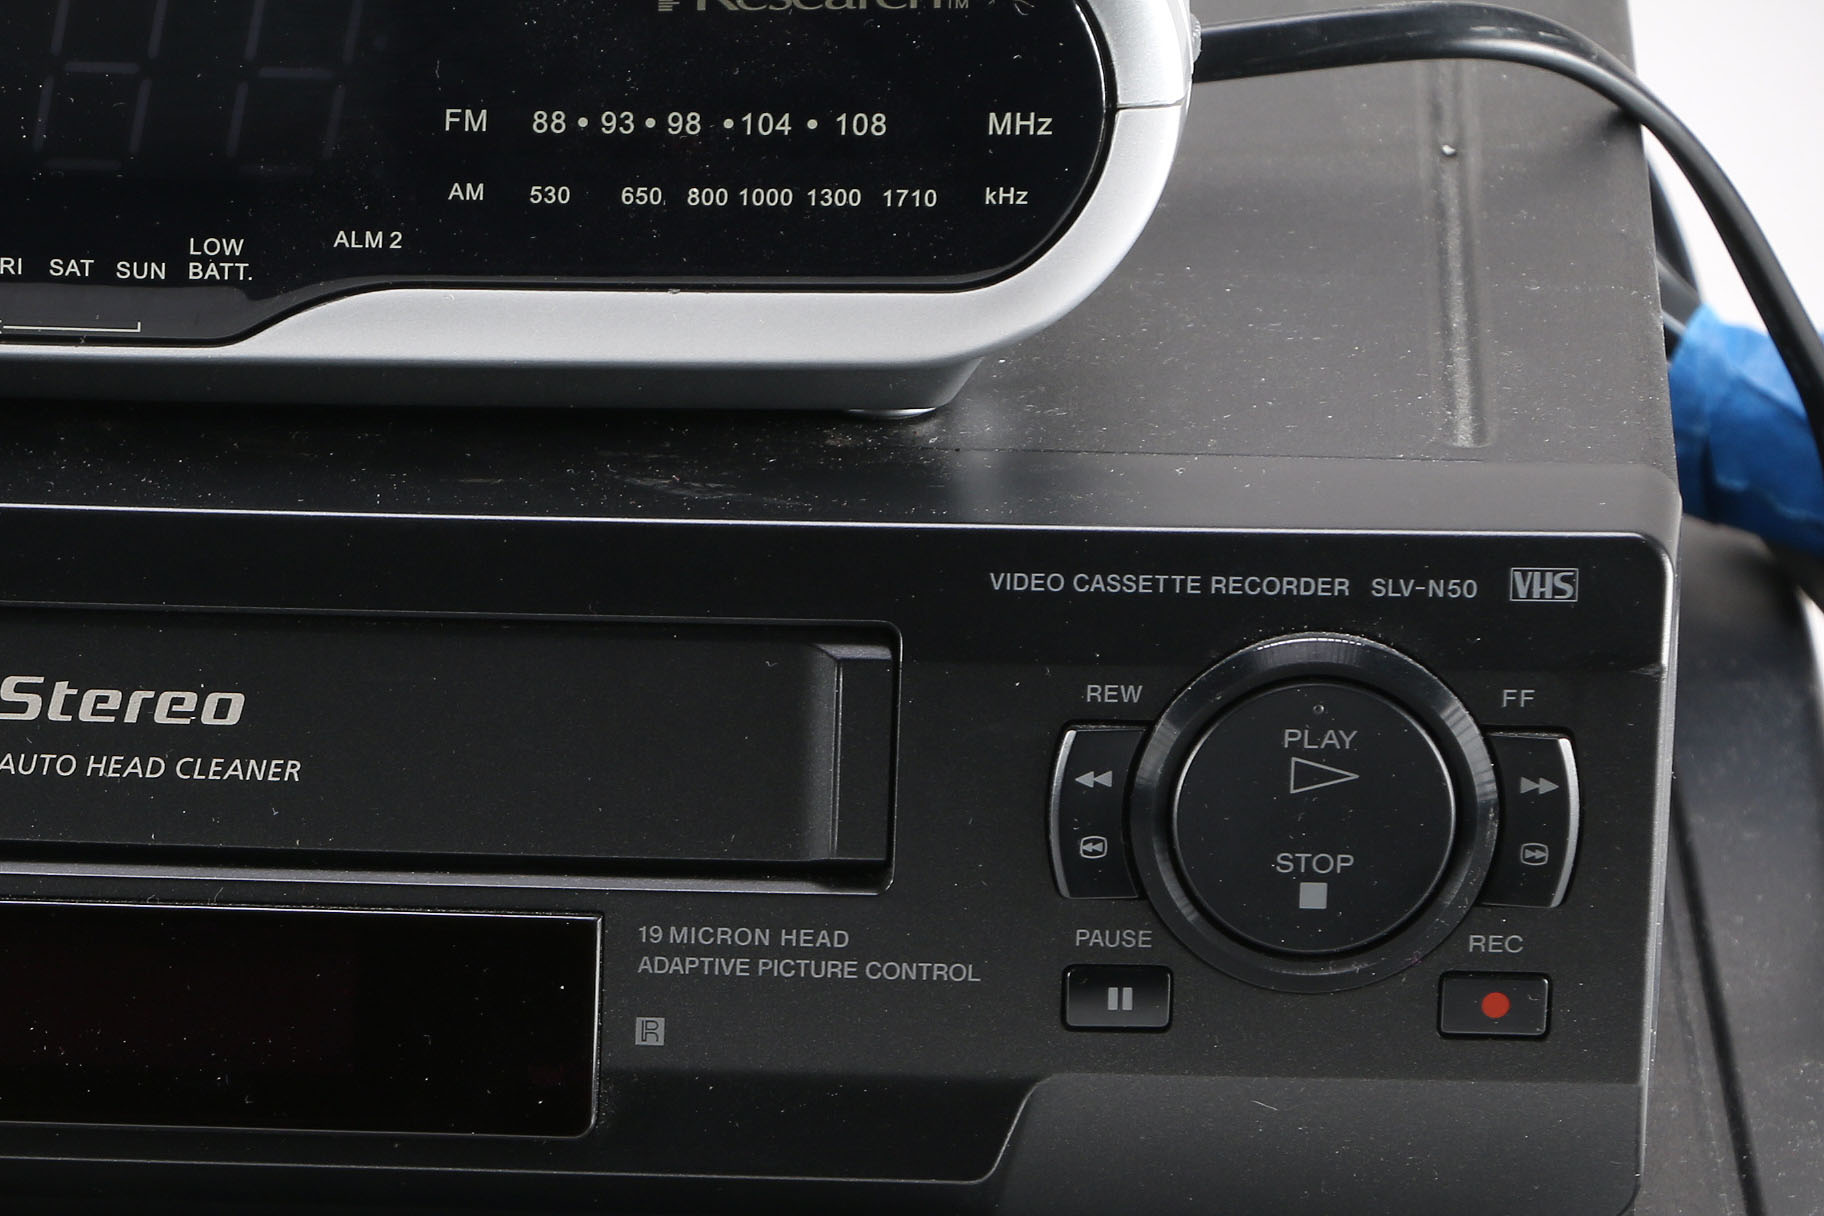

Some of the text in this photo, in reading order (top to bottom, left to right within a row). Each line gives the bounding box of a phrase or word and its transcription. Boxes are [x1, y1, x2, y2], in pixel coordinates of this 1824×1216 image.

[444, 109, 1053, 137] FM 88 93 98 104 108 MHz
[448, 183, 1029, 209] AM 530 650 800 1000 1300 1710 kHz
[189, 238, 244, 256] LOW
[333, 230, 402, 249] ALM 2
[49, 259, 95, 278] SAT
[116, 261, 166, 280] SUN
[188, 263, 253, 281] BATT.
[989, 573, 1478, 599] VIDEO CASSETTE RECORDER SLV-N50
[1509, 567, 1579, 602] VHS
[1086, 684, 1143, 704] REW
[1502, 689, 1535, 708] FF
[1283, 729, 1358, 750] PLAY
[86, 755, 166, 779] HEAD
[175, 757, 302, 783] CLEANER
[1275, 853, 1355, 875] STOP
[638, 926, 849, 948] 19 MICRON HEAD
[1075, 928, 1152, 950] PAUSE
[1468, 934, 1524, 954] REC
[637, 956, 981, 982] ADAPTIVE PICTURE CONTROL
